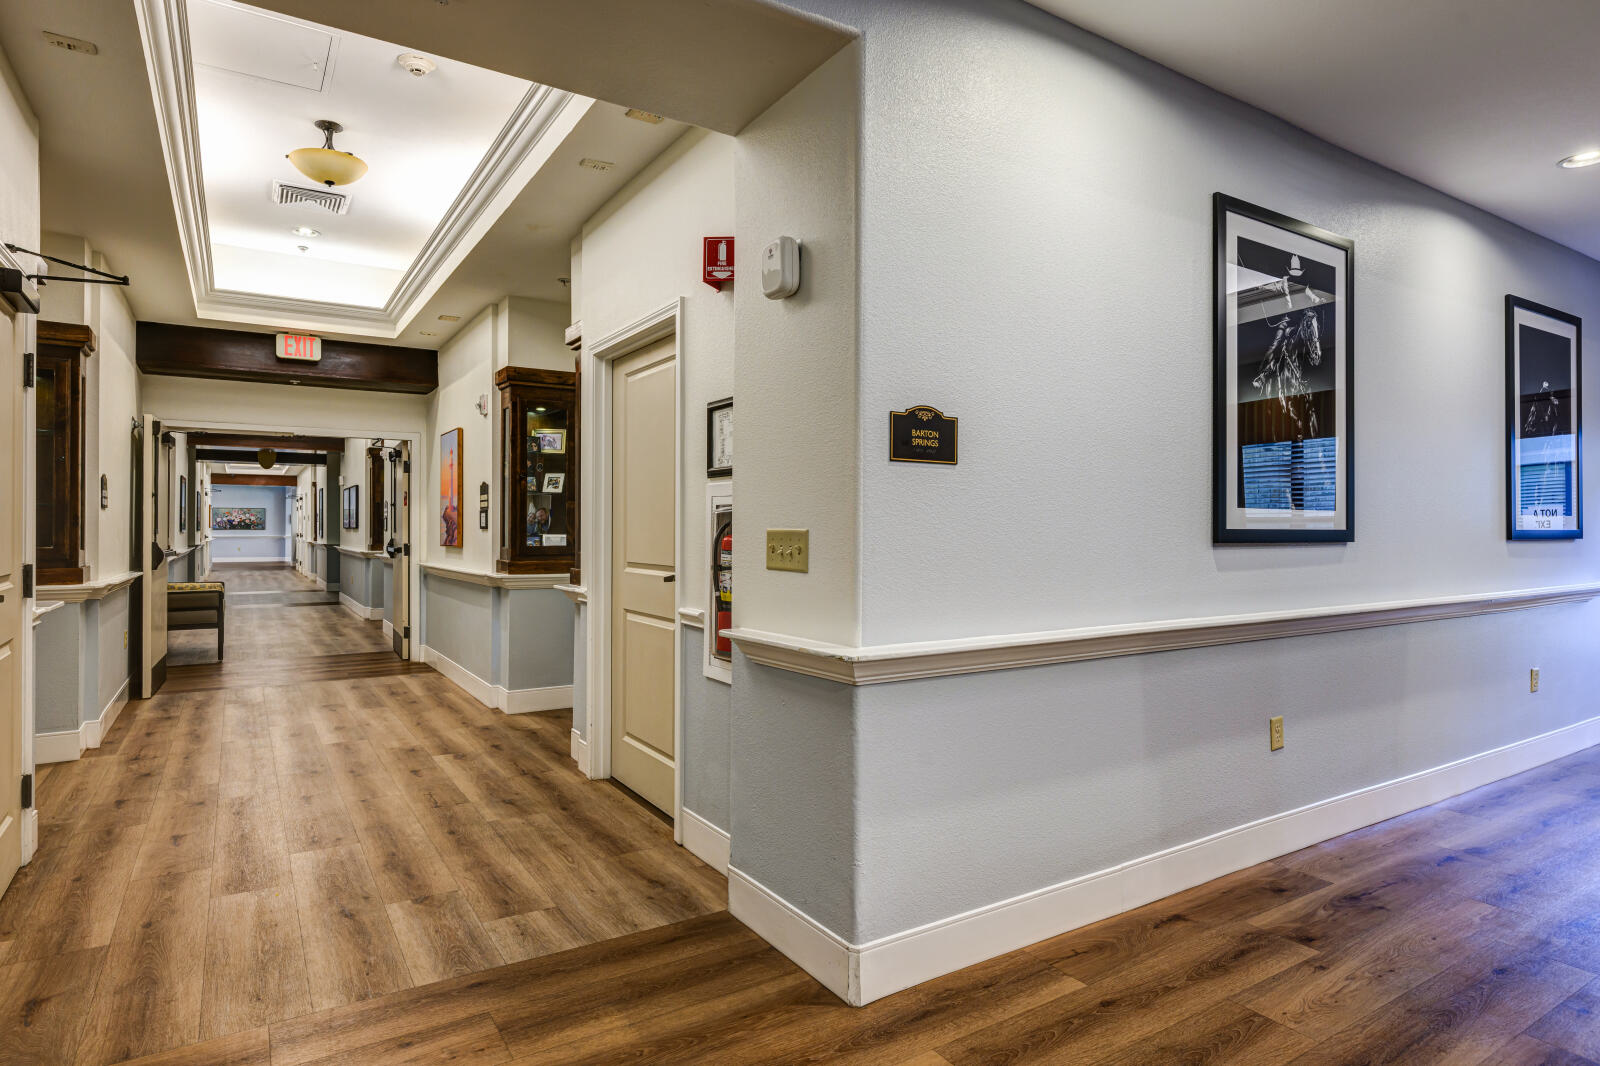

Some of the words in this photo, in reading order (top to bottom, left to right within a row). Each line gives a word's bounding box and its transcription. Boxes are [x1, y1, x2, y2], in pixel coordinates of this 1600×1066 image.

[284, 335, 316, 358] EXIT
[911, 428, 939, 439] BARTON
[911, 438, 939, 448] SPRINGS
